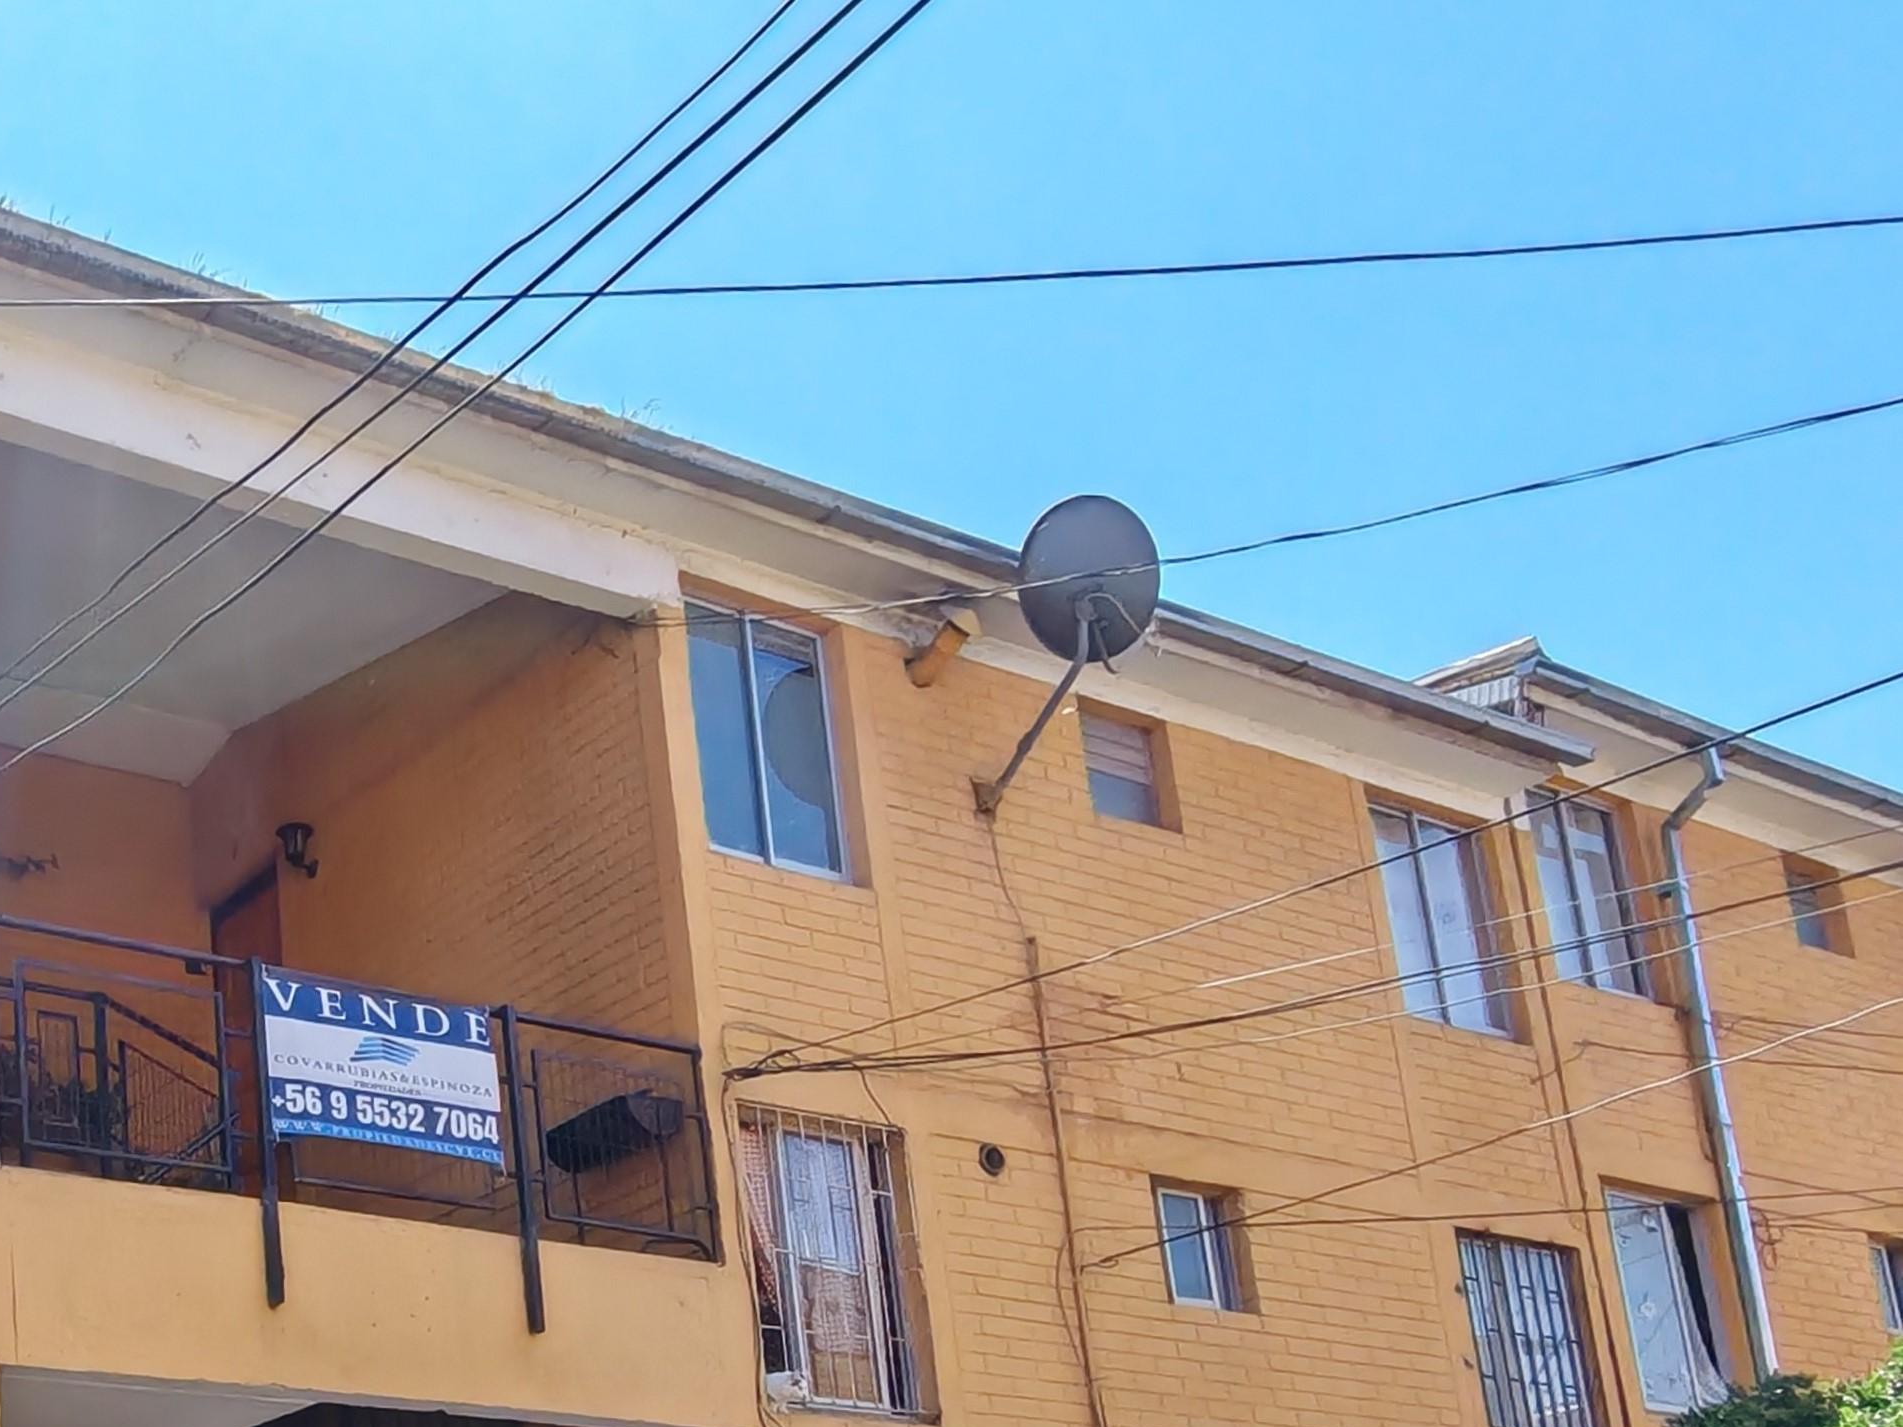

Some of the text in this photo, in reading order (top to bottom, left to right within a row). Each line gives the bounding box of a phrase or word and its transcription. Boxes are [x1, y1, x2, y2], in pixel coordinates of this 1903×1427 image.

[265, 978, 490, 1046] VENDE
[271, 1083, 500, 1145] +56 9 5532 7064
